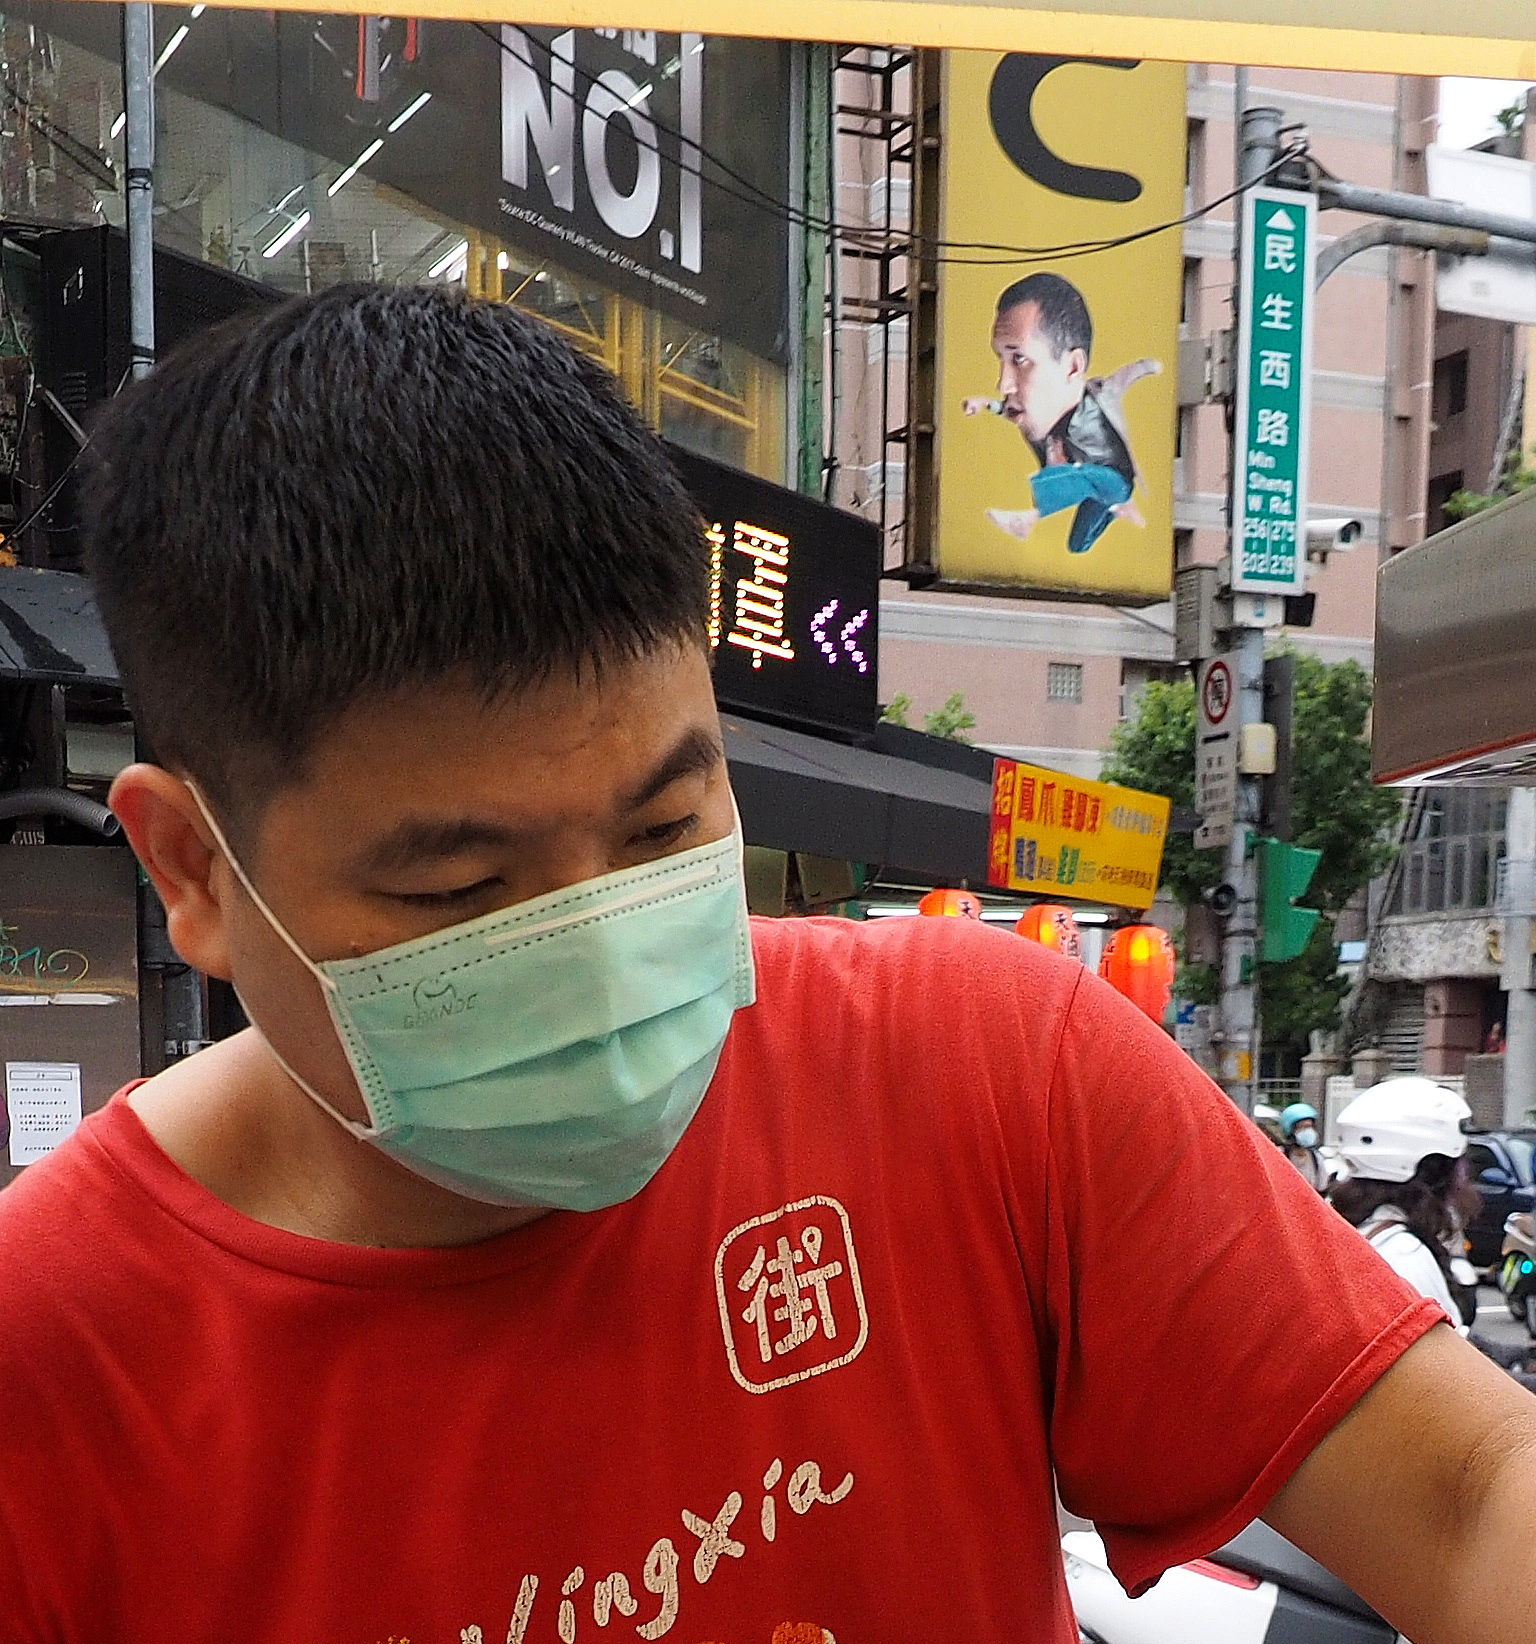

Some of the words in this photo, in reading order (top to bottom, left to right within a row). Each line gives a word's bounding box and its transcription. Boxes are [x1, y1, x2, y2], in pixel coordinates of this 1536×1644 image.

[1257, 233, 1296, 446] 民生西路
[735, 1225, 842, 1363] 街
